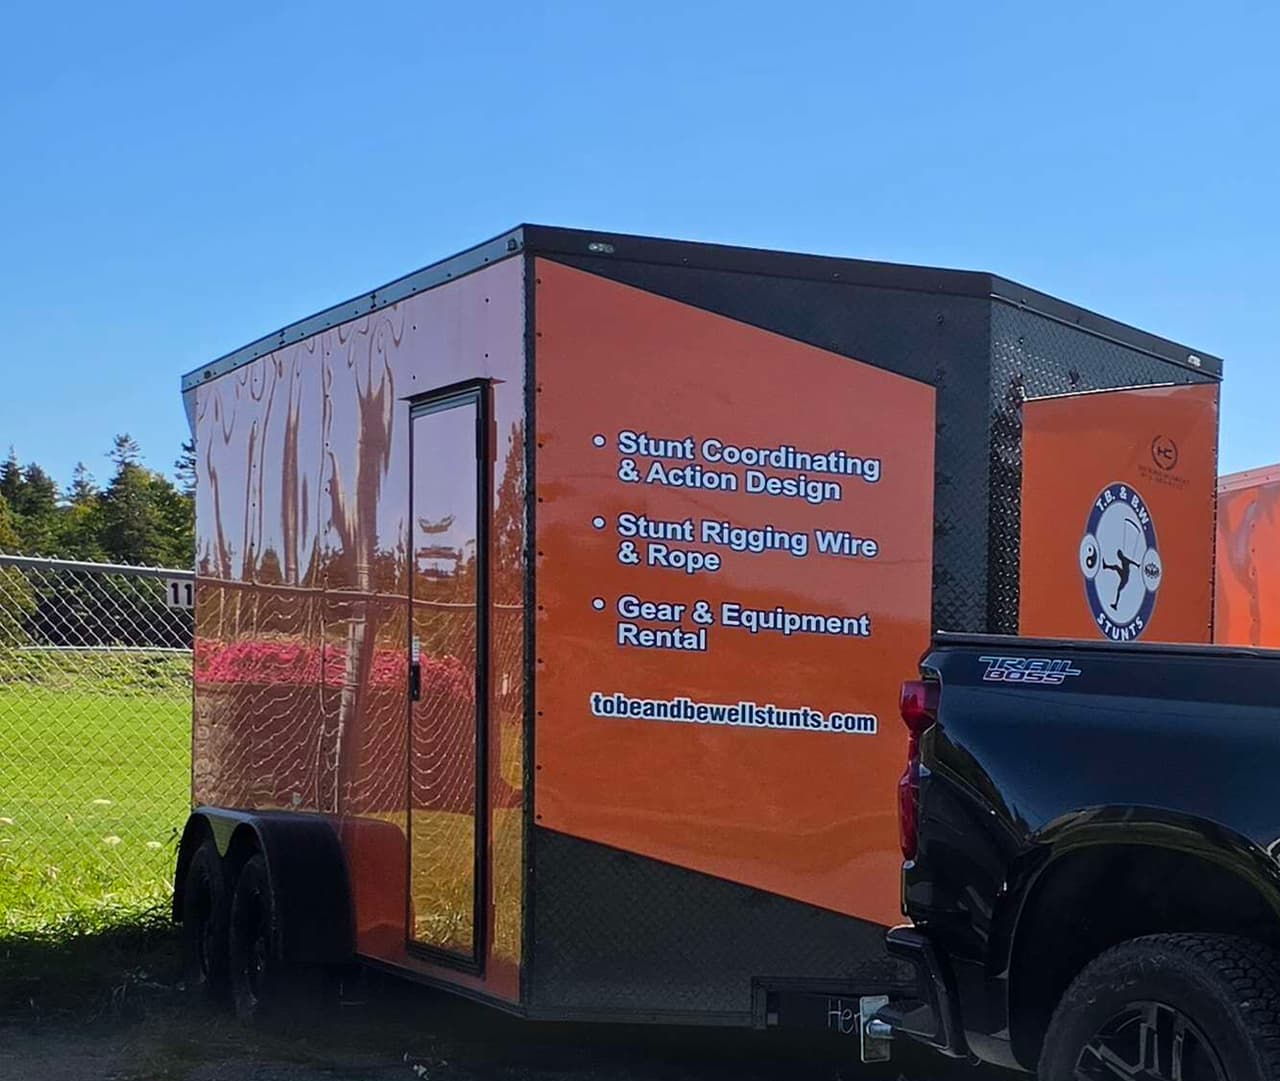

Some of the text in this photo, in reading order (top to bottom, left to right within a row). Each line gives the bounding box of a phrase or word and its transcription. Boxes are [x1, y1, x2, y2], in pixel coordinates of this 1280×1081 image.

[618, 430, 881, 482] Stunt Coordinating
[618, 459, 841, 503] & Action Design
[1096, 490, 1115, 511] T.B.
[1120, 486, 1127, 499] &
[618, 513, 878, 557] Stunt Rigging Wire
[618, 542, 721, 574] & Rope
[618, 595, 870, 637] Gear & Equipment
[1097, 613, 1143, 640] STUNTS
[618, 623, 706, 650] Rental
[979, 656, 1081, 675] TRAIL
[983, 669, 1065, 684] BOSS
[591, 692, 877, 734] tobeandbewellstunts.com
